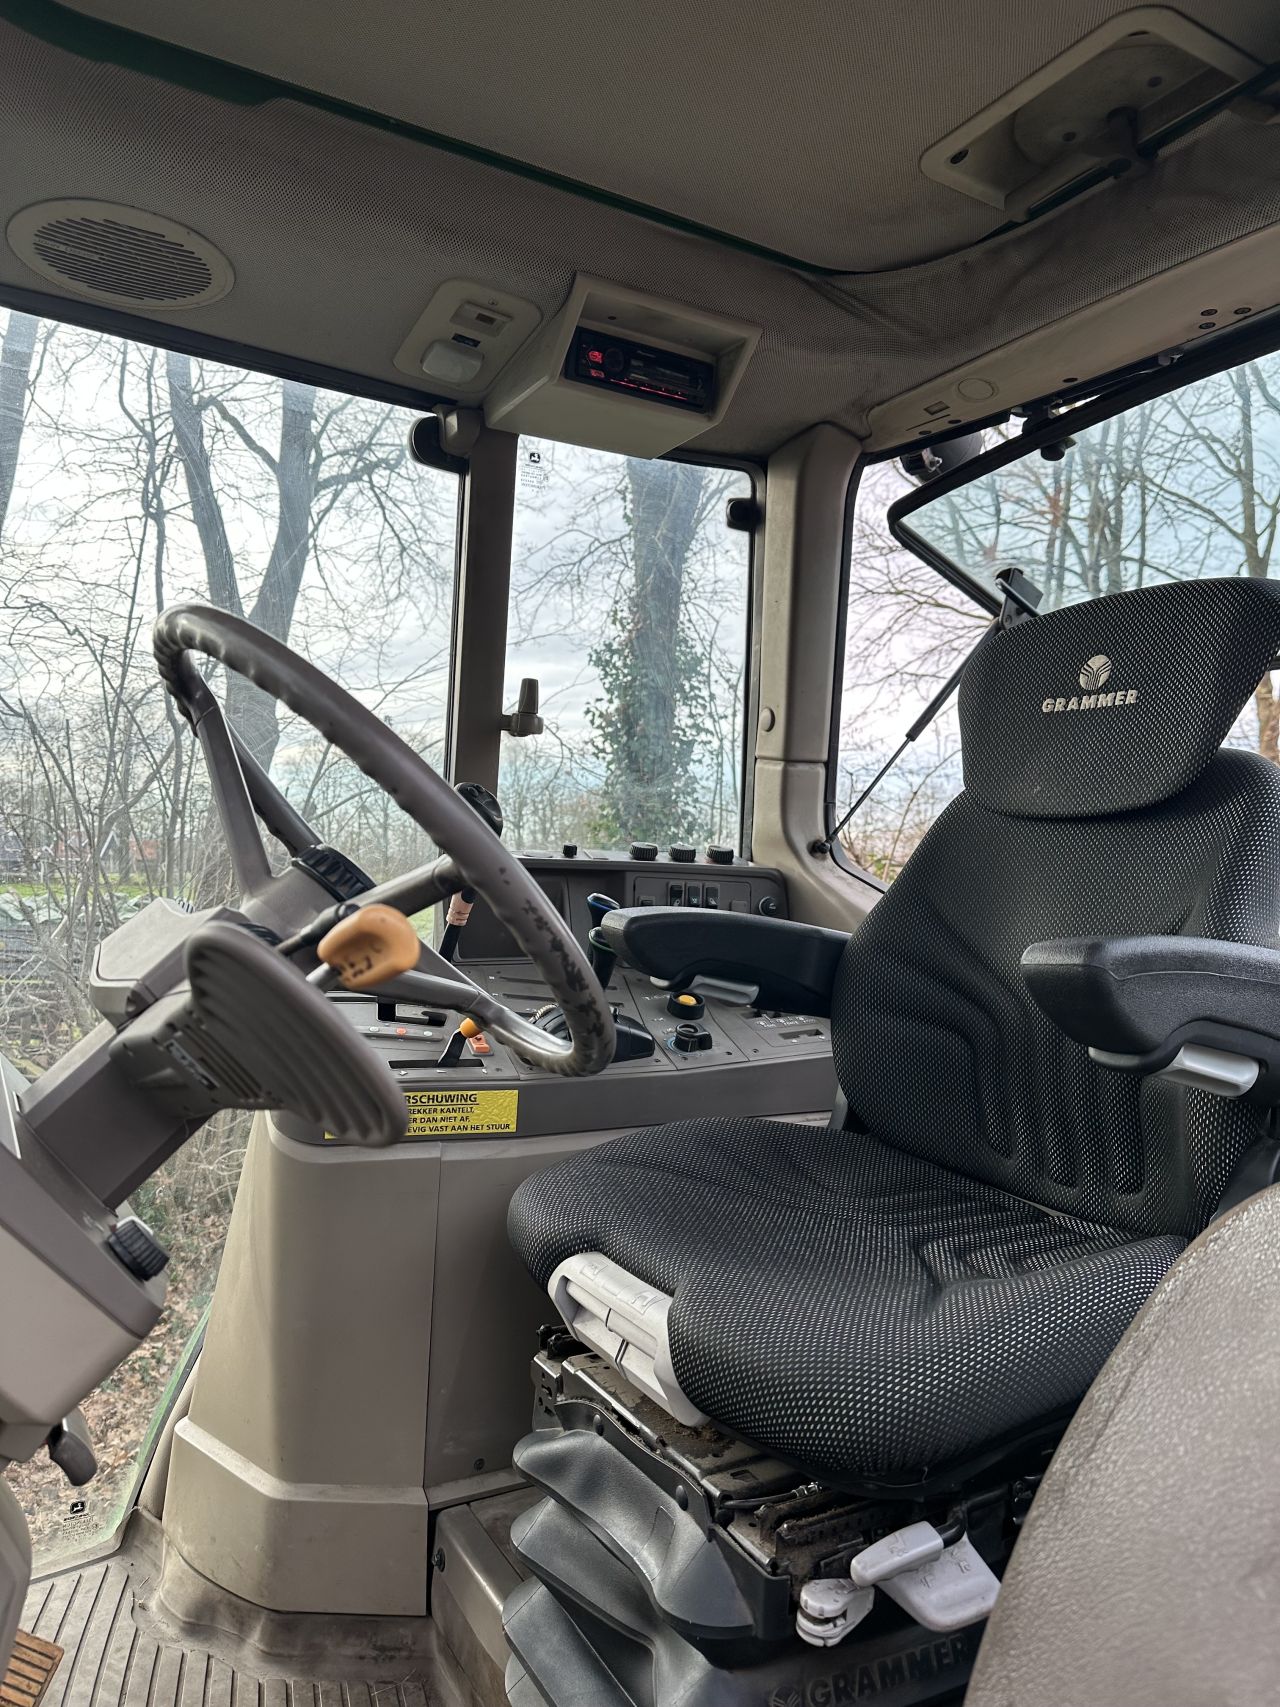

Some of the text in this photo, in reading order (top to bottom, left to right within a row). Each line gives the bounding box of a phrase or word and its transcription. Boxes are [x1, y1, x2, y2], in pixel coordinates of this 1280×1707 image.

[1042, 689, 1138, 713] GRAMMER
[405, 1093, 478, 1104] RSCHUWING
[409, 1106, 475, 1115] REKKER KANTELT,
[486, 1123, 510, 1131] STUUR
[807, 1633, 970, 1707] GRAMMER
